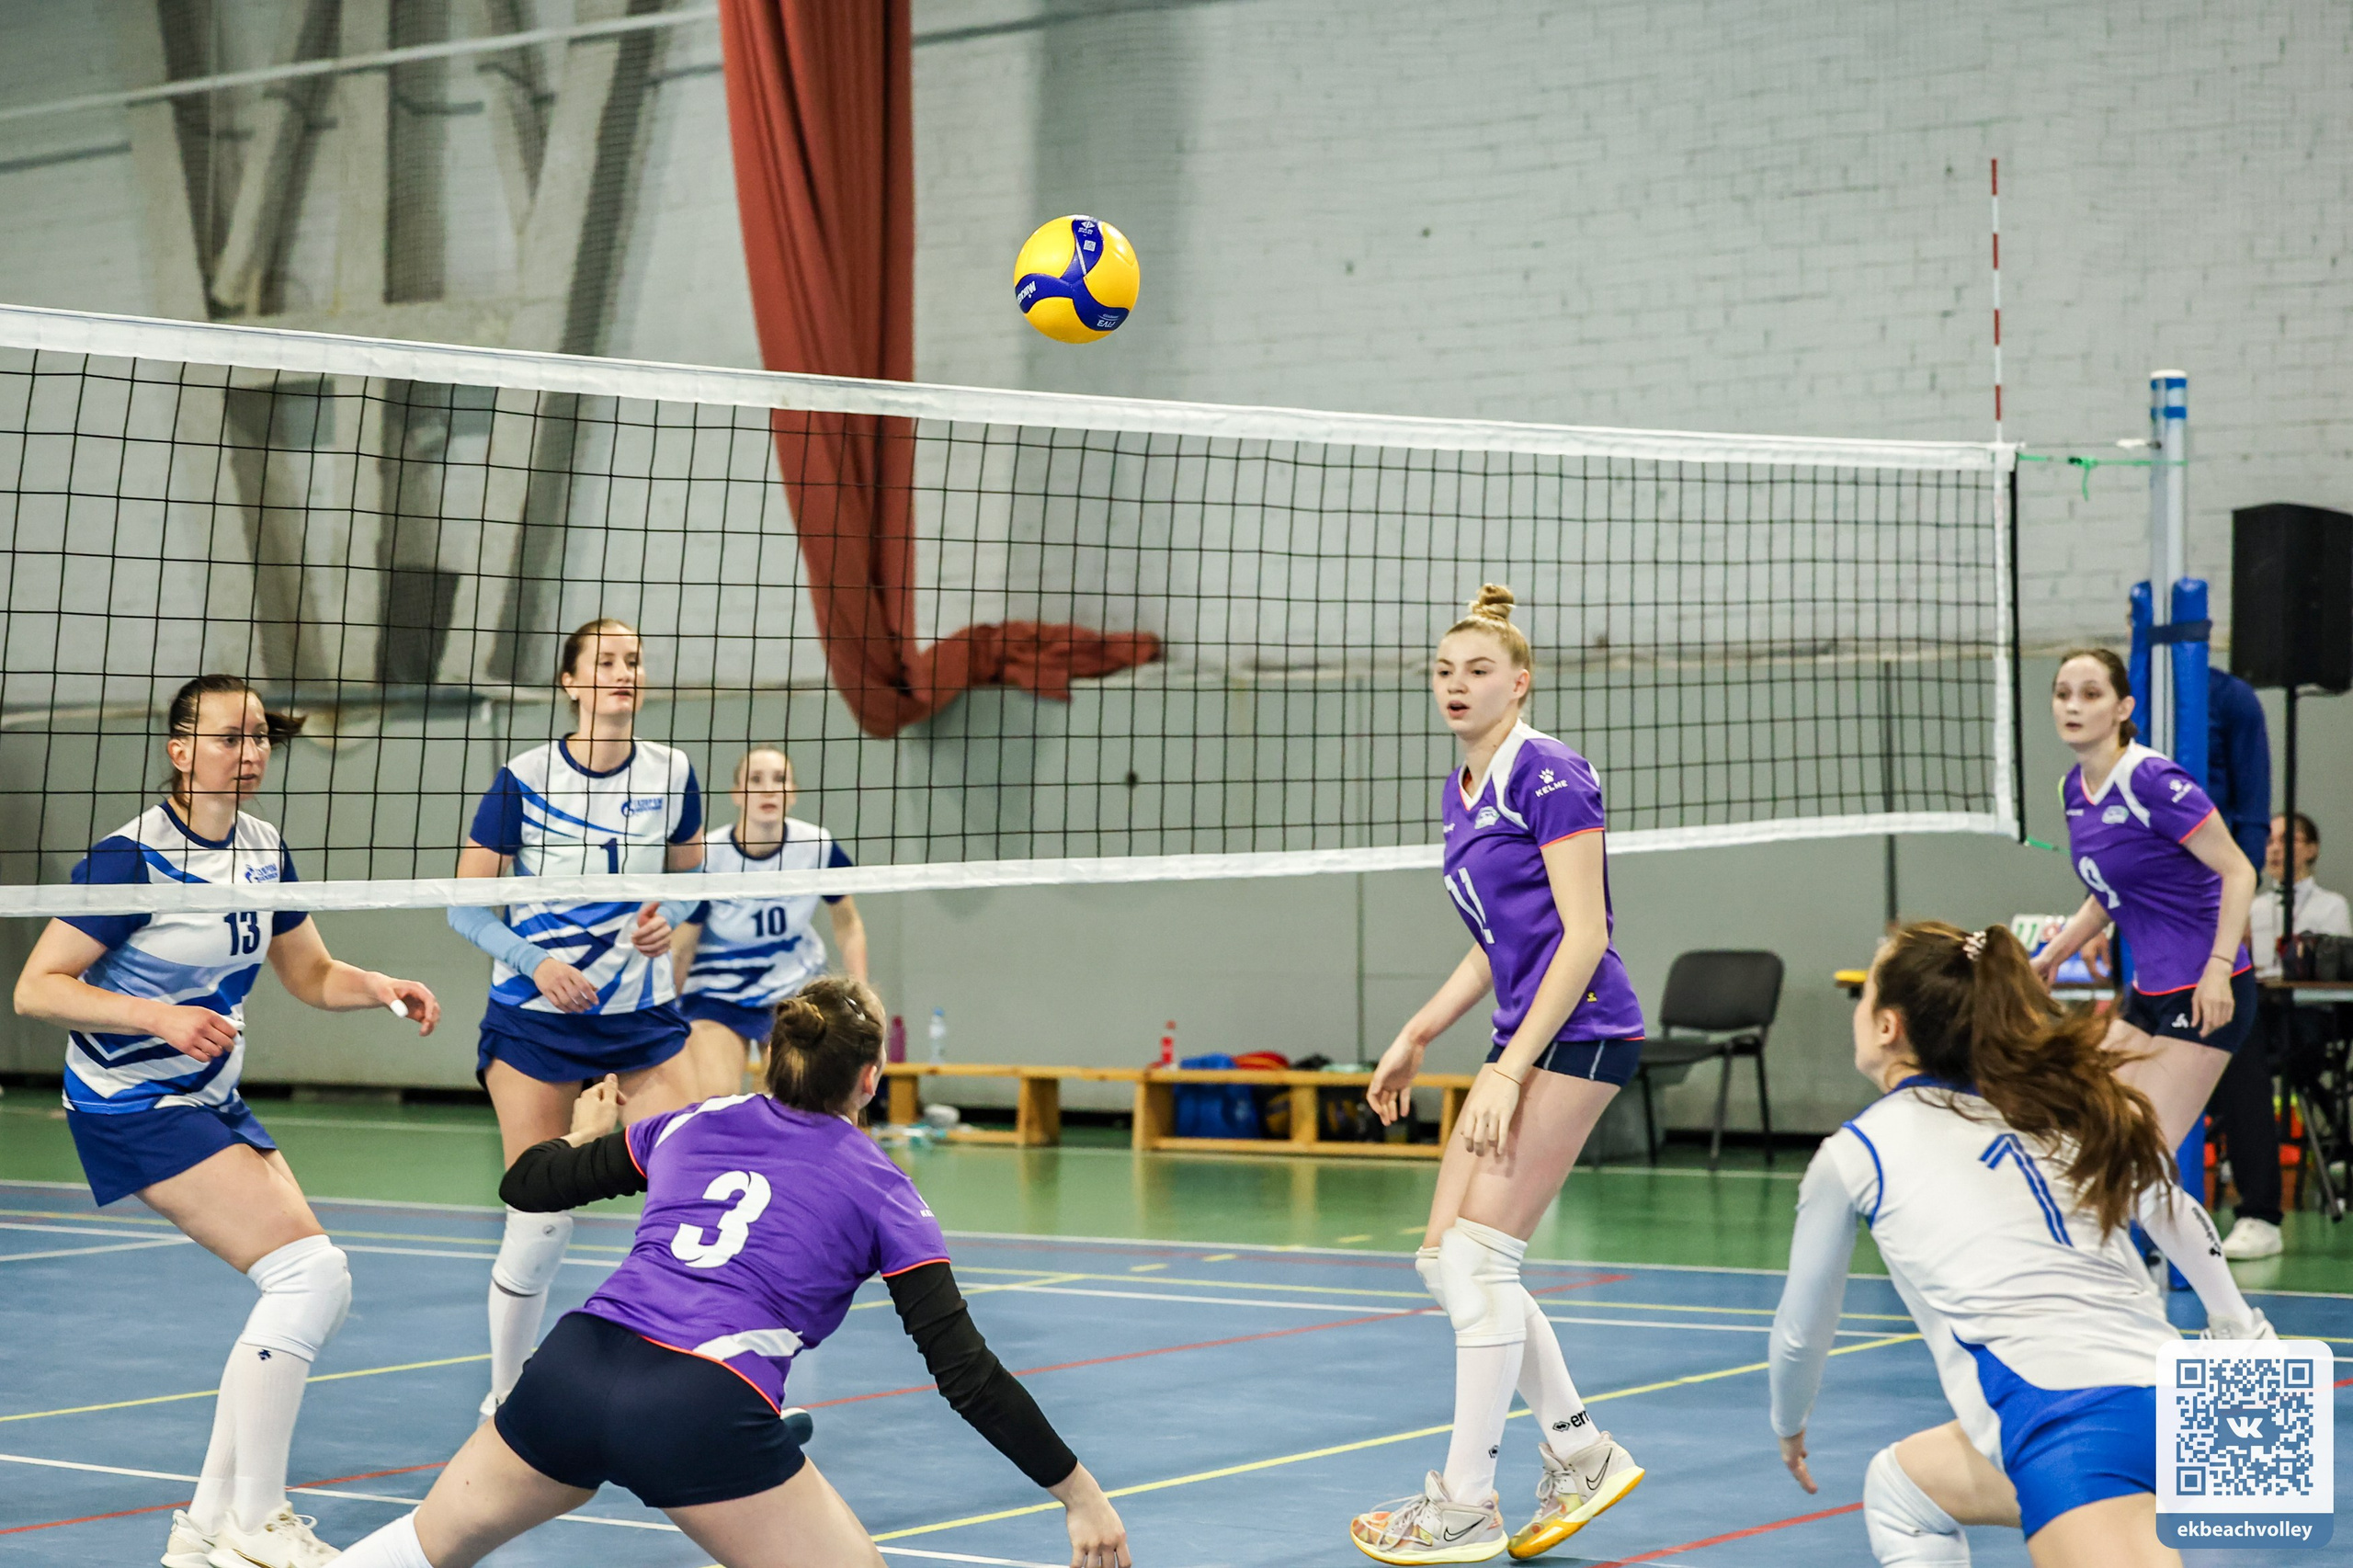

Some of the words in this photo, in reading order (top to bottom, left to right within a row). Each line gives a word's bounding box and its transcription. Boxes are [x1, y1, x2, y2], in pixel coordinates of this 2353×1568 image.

[1535, 779, 1568, 798] KELME
[599, 837, 619, 874] 1
[2078, 856, 2120, 910] 9
[751, 906, 787, 937] 10
[1444, 867, 1495, 944] 11
[223, 911, 260, 956] 13
[670, 1170, 772, 1268] 3
[1571, 1410, 1590, 1427] err
